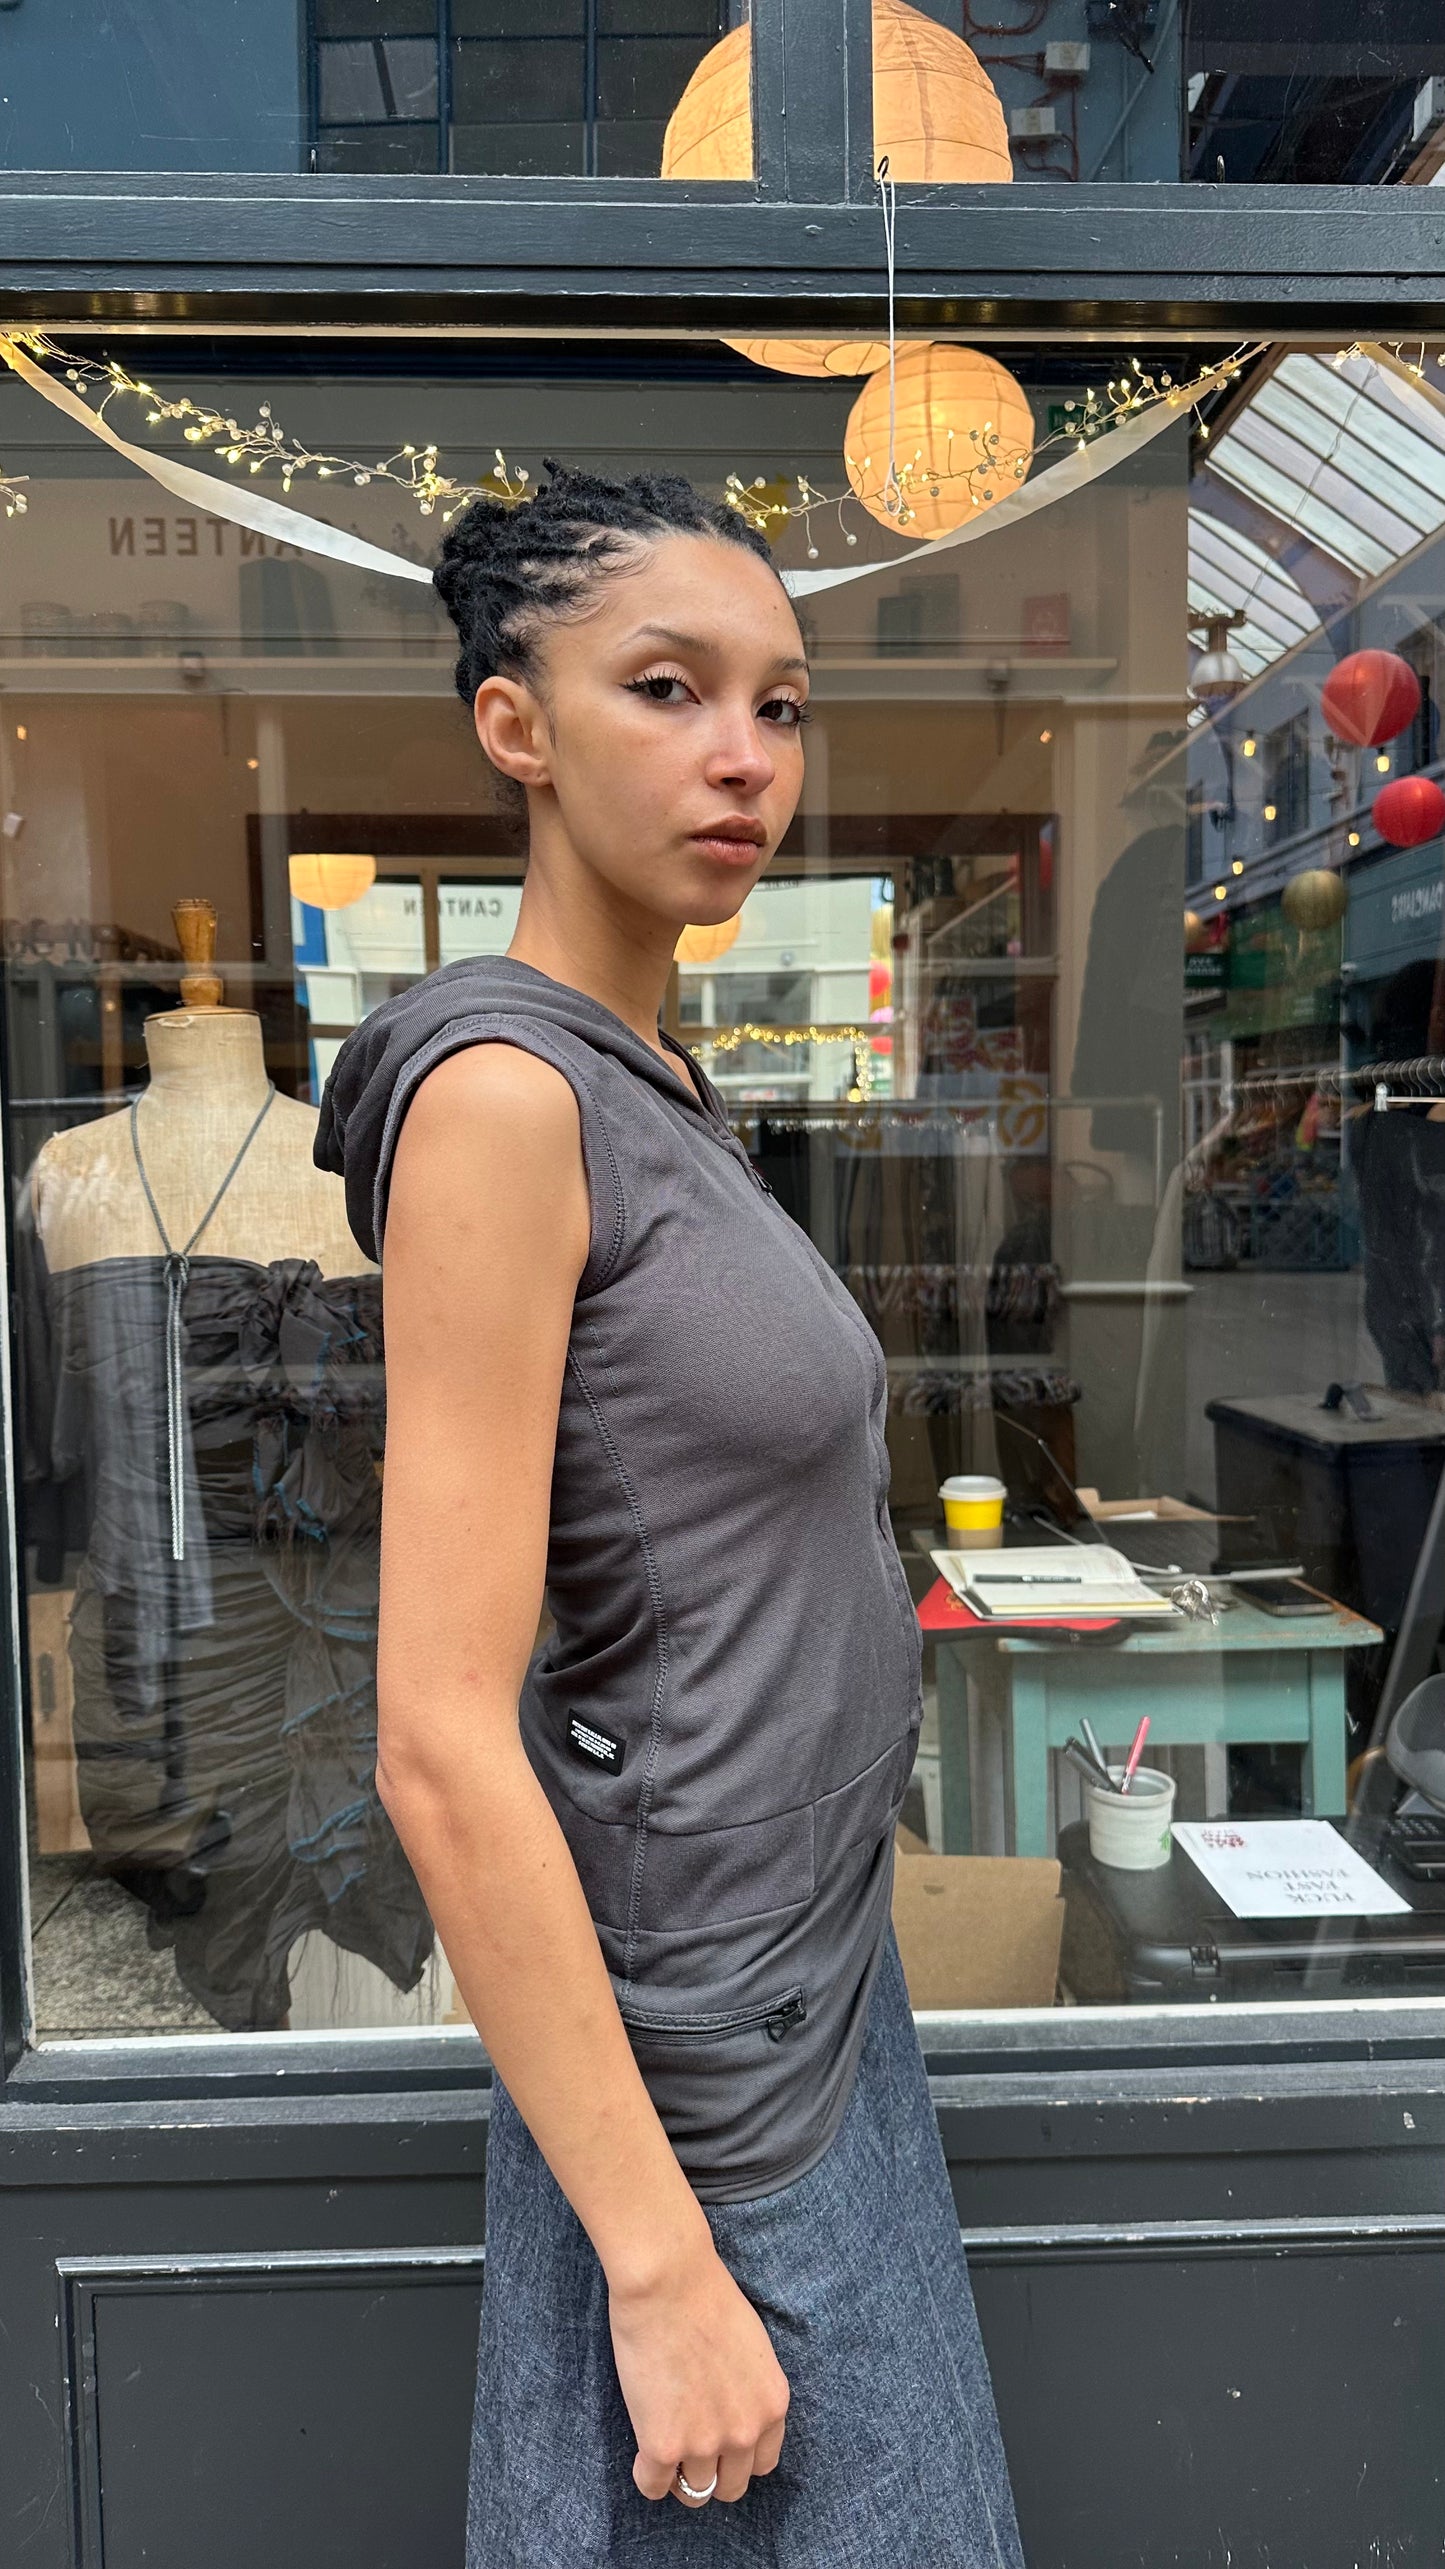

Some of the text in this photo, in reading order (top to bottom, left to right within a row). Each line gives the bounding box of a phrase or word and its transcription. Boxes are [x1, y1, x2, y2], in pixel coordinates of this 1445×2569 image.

[1246, 1869, 1350, 1880] FASHION
[1284, 1881, 1339, 1891] FAST
[1286, 1893, 1355, 1903] FUCK
